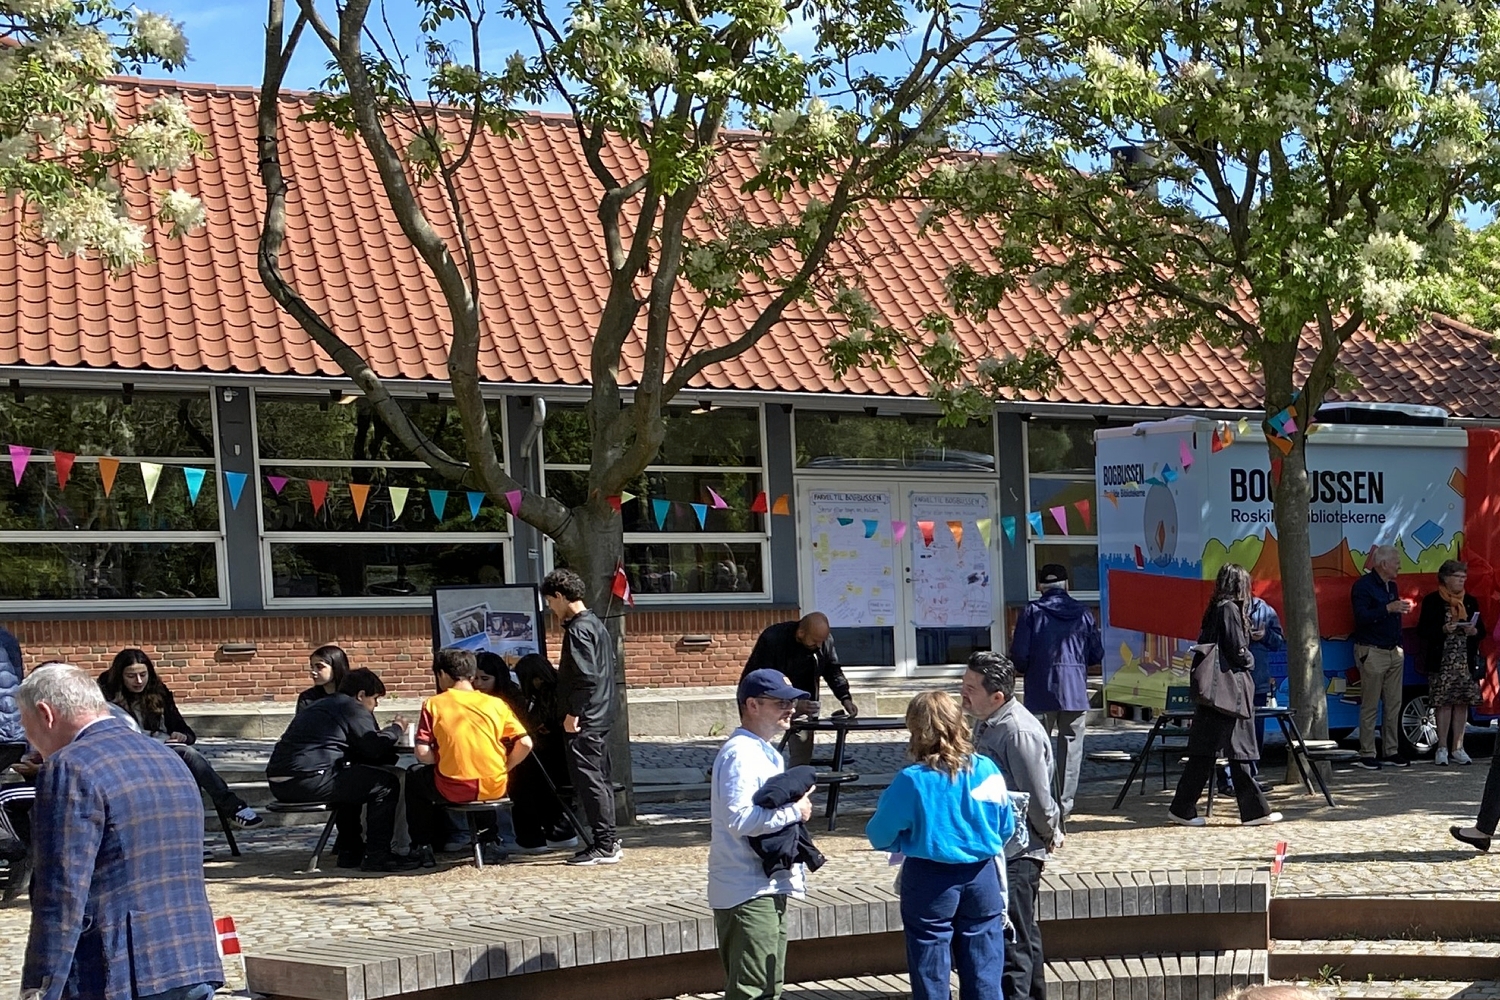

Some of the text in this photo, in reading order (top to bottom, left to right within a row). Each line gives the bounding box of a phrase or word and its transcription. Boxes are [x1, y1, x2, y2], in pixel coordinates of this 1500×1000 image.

[1103, 463, 1145, 486] BOGBUSSEN
[1231, 509, 1386, 524] Roskil ibliotekerne
